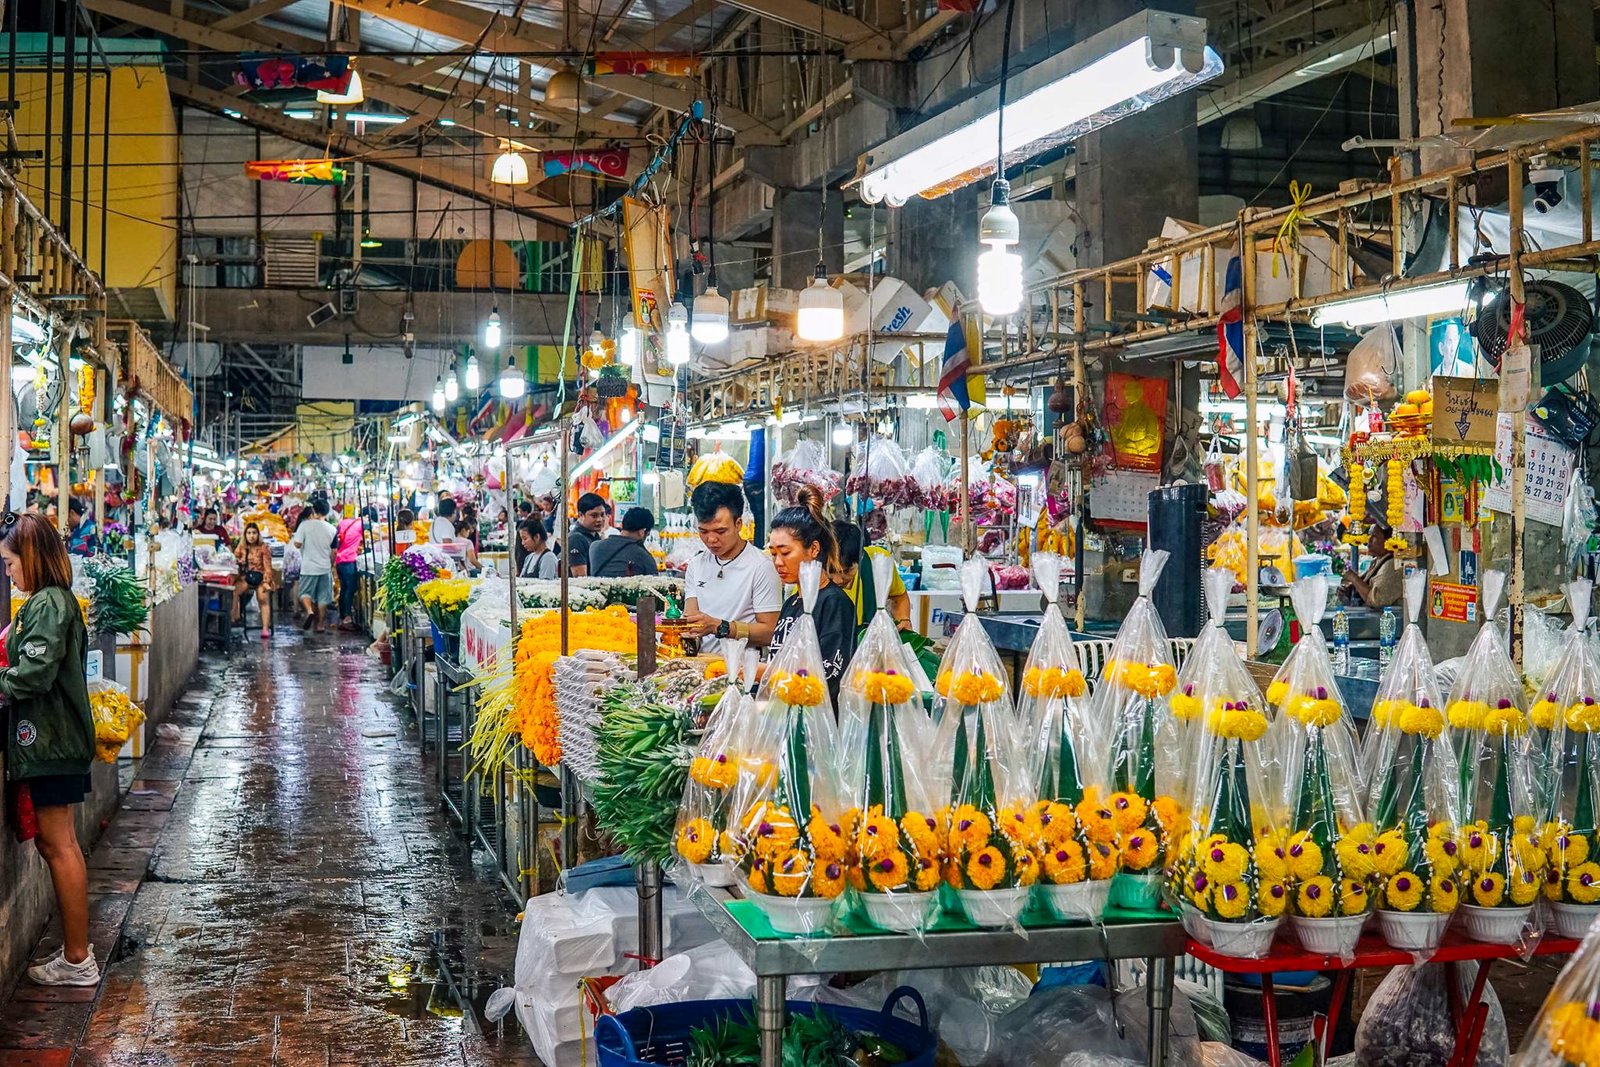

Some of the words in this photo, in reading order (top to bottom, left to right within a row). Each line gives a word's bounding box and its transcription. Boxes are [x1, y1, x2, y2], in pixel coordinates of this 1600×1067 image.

[880, 306, 912, 333] resh
[1530, 426, 1545, 436] 12
[1497, 453, 1503, 462] 9
[1527, 461, 1536, 472] 12
[1538, 464, 1547, 474] 13
[1548, 467, 1556, 477] 14
[1559, 470, 1567, 480] 15
[1530, 449, 1537, 459] 5
[1541, 451, 1547, 462] 6
[1551, 455, 1557, 464] 7
[1504, 468, 1513, 477] 17
[1525, 473, 1534, 483] 19
[1535, 476, 1544, 486] 20
[1545, 478, 1554, 489] 21
[1556, 481, 1565, 491] 22
[1524, 485, 1532, 495] 26
[1533, 488, 1542, 498] 27
[1543, 490, 1552, 501] 28
[1554, 493, 1563, 503] 29
